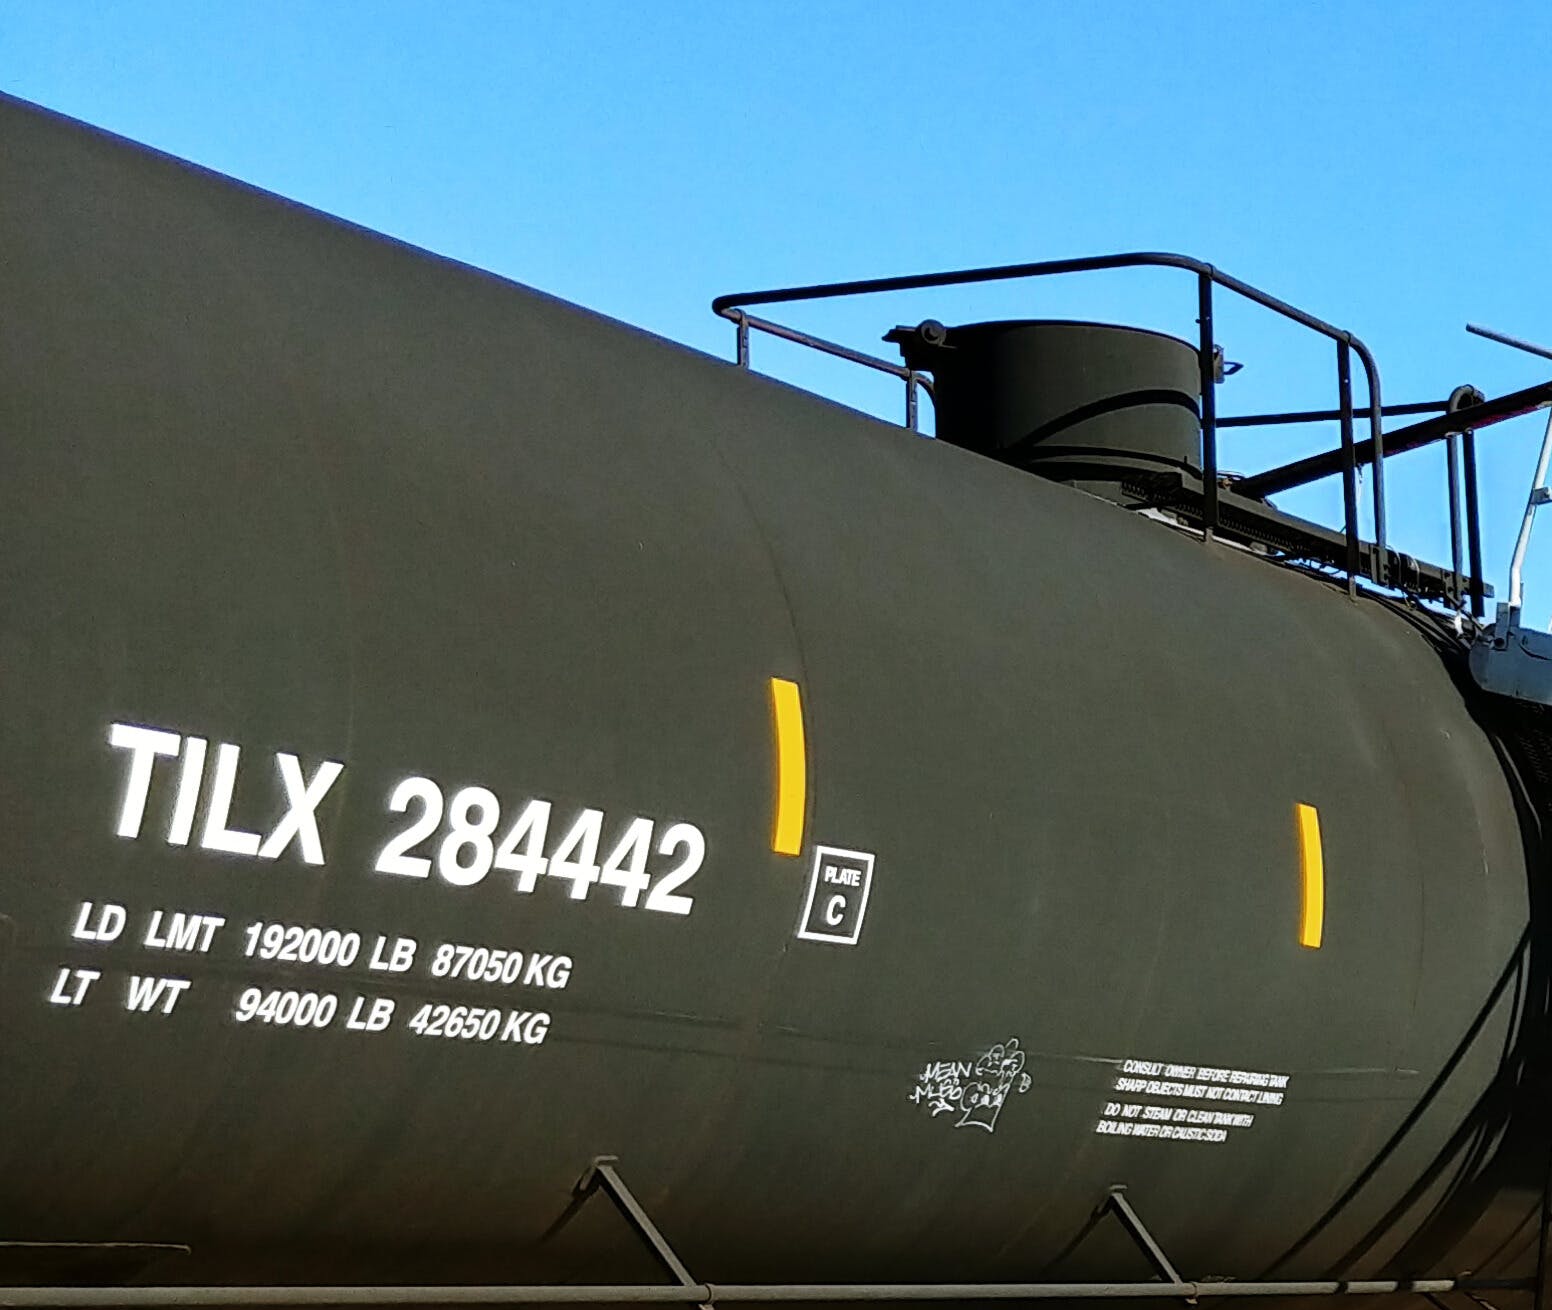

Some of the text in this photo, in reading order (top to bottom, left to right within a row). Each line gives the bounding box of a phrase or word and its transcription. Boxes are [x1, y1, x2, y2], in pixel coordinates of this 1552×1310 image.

[107, 722, 705, 915] TILX 284442
[824, 865, 862, 887] PLATE
[826, 894, 846, 926] C
[73, 901, 574, 989] LD LMT 192000 LB 87050 KG
[49, 968, 551, 1046] LT WT 94000 LB 42650 KG
[1104, 1102, 1121, 1117] DO
